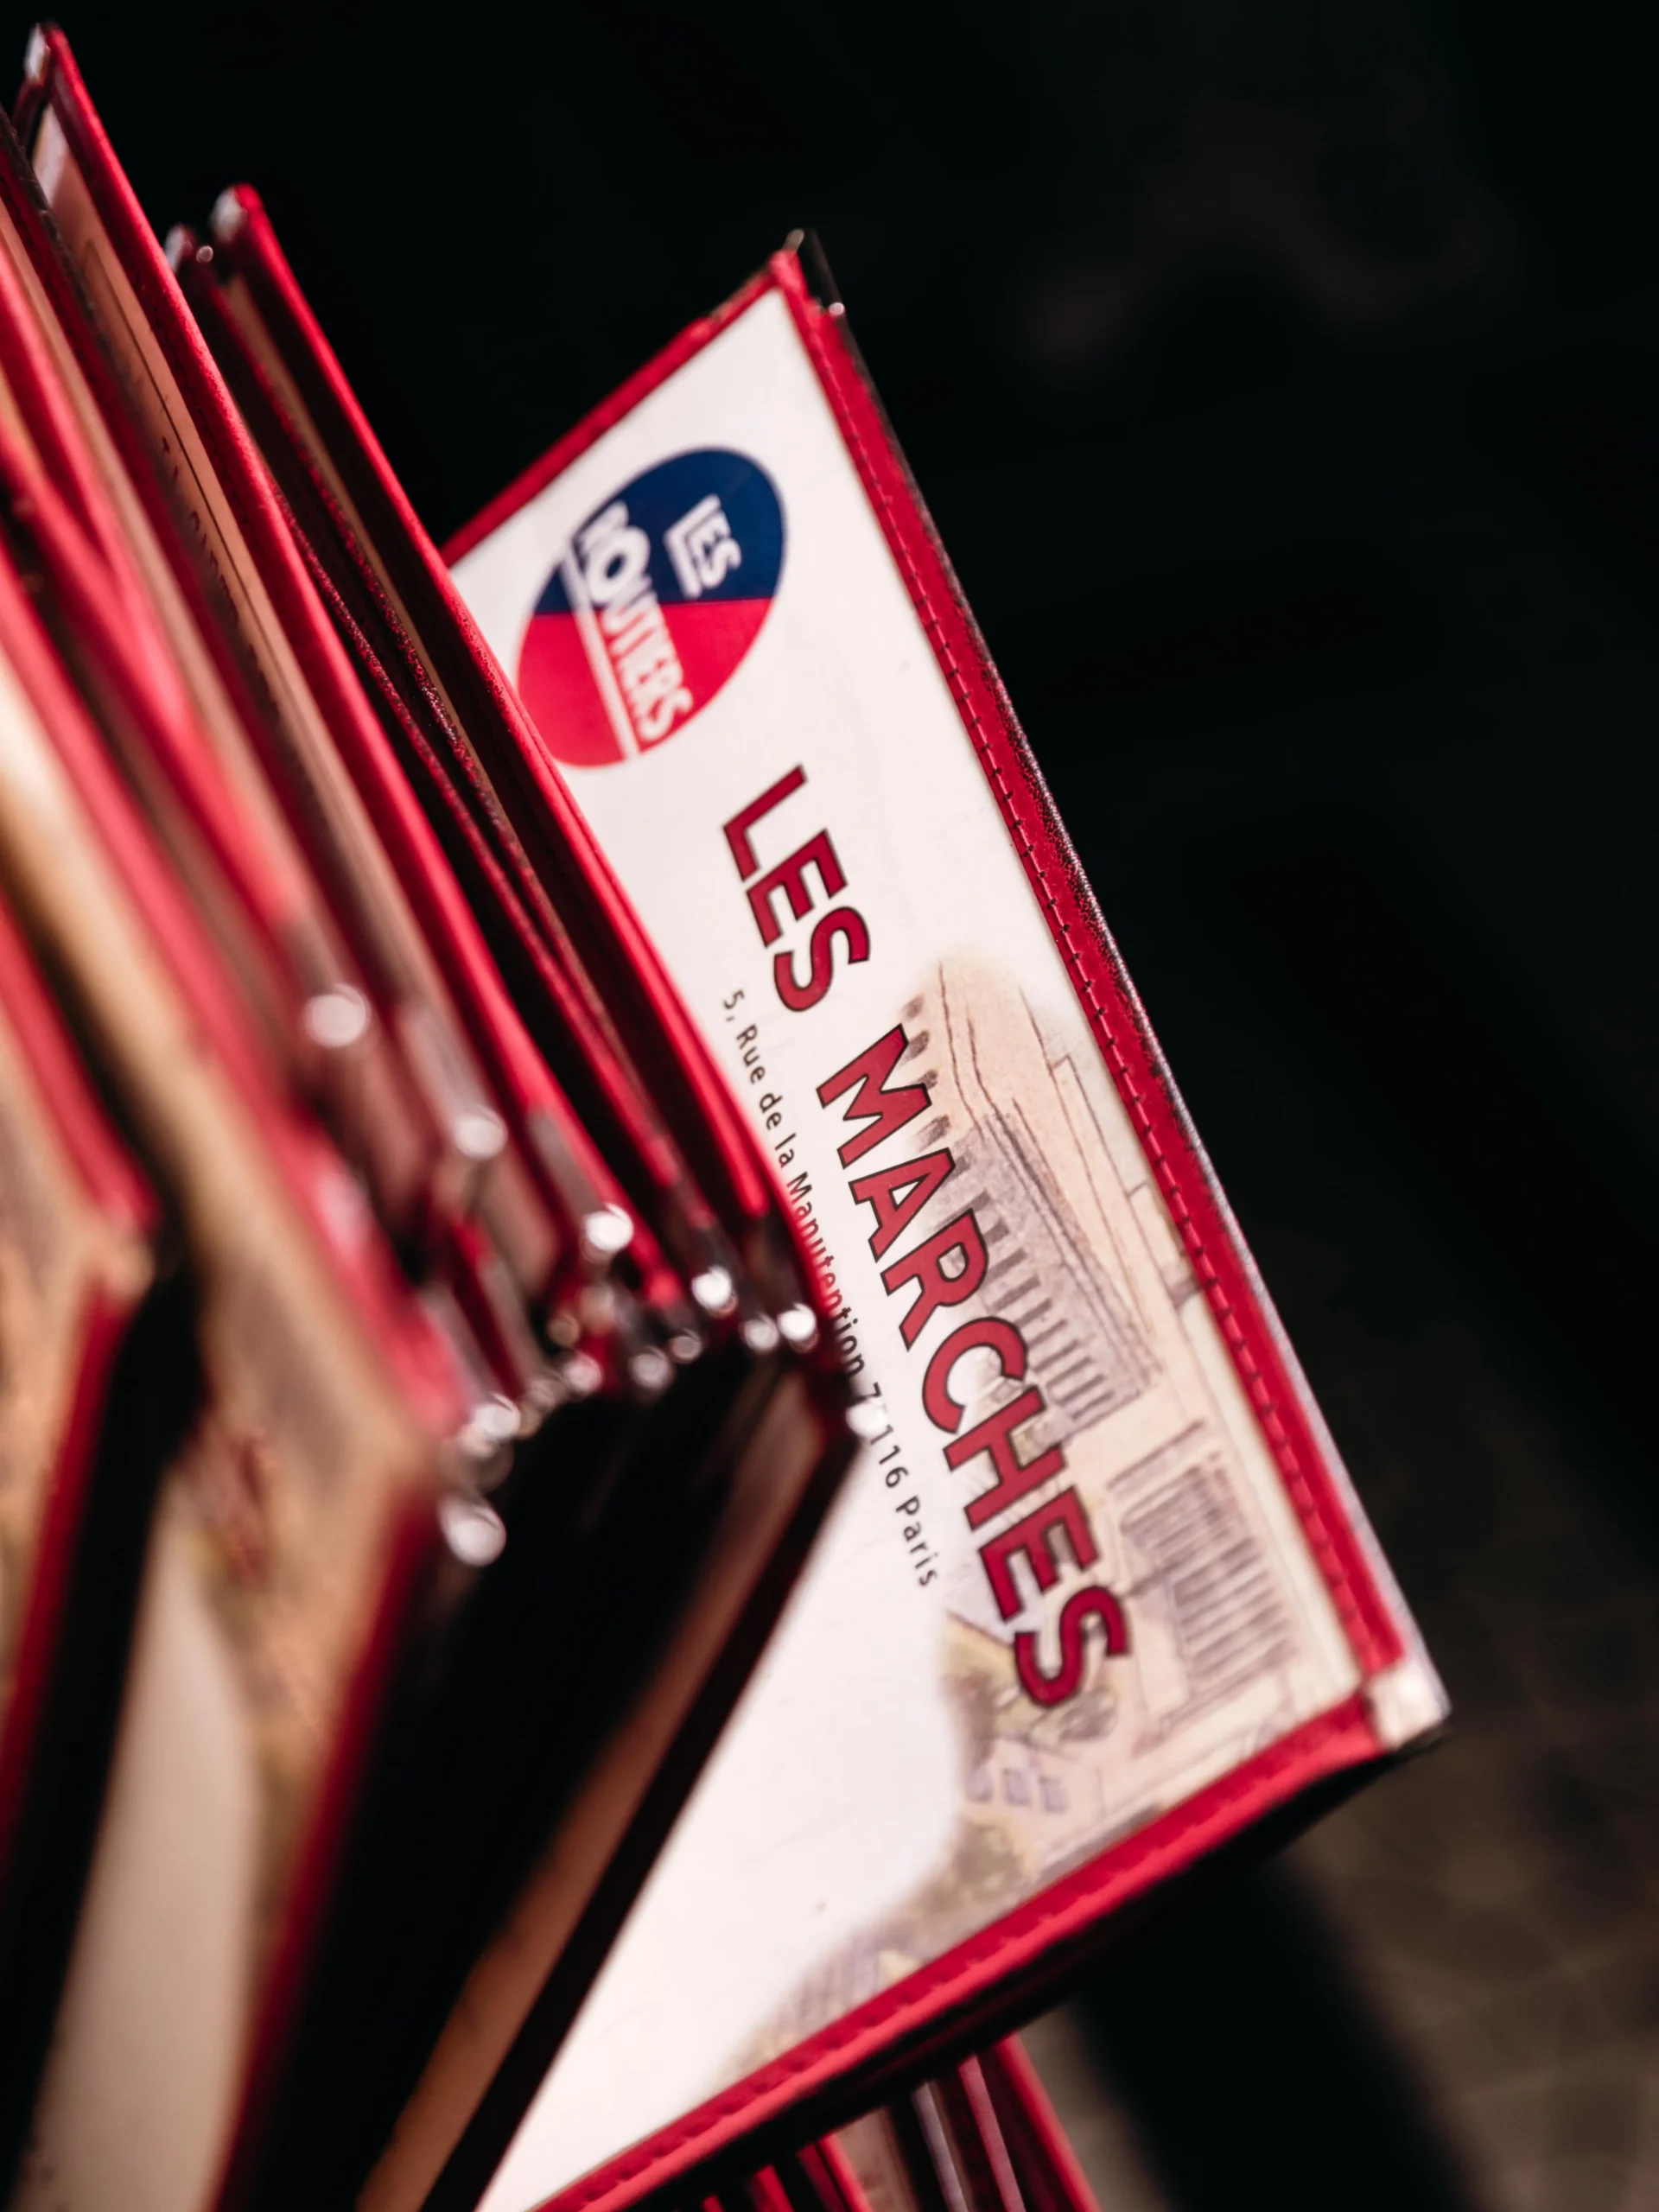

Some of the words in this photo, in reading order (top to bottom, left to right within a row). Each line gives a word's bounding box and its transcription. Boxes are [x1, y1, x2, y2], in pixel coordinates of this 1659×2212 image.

[575, 499, 693, 742] ROUTIERS
[663, 493, 743, 600] LES
[722, 764, 871, 1013] LES
[816, 1022, 1131, 1710] MARCHES
[722, 989, 745, 1021] 5,
[736, 1023, 766, 1084] Rue
[759, 1091, 784, 1131] de
[774, 1133, 797, 1169] la
[852, 1382, 909, 1489] 7116
[895, 1496, 939, 1587] Paris
